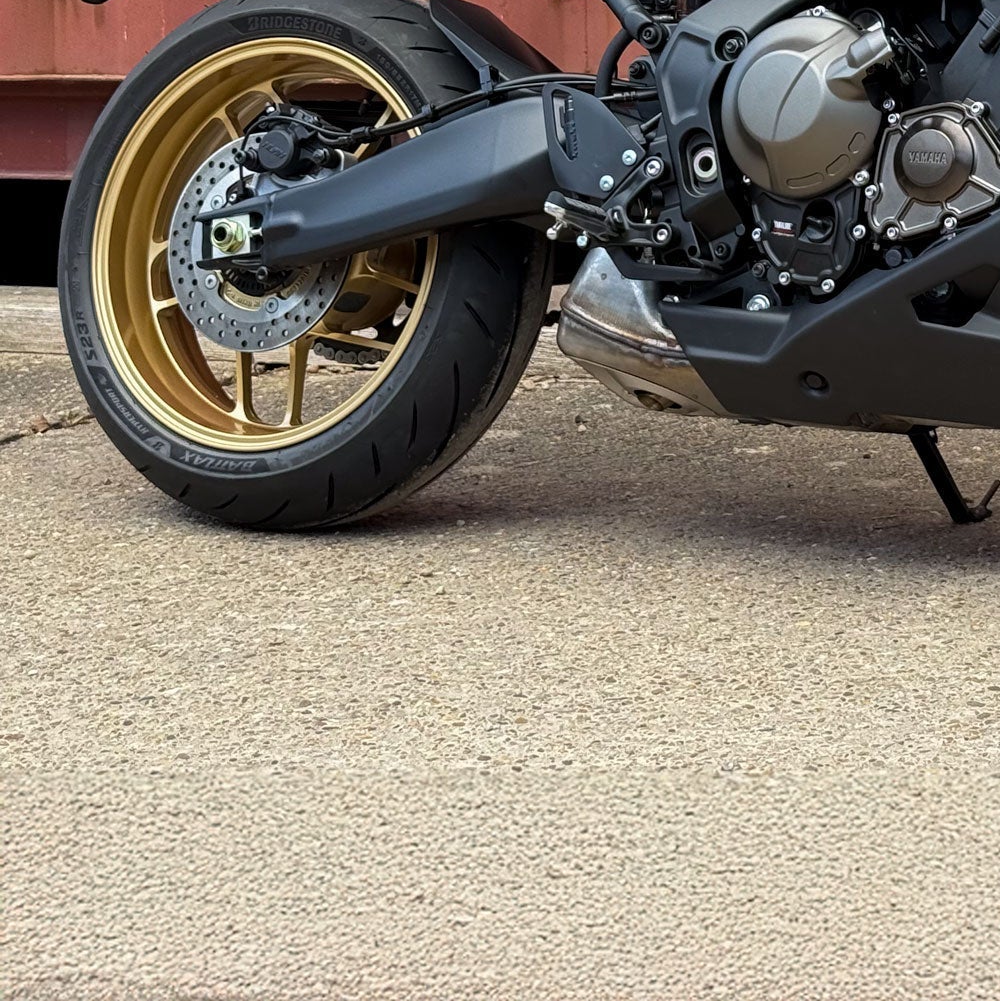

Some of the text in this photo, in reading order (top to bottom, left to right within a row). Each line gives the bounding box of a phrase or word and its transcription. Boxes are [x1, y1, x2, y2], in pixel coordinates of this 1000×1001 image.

[247, 16, 343, 40] BRIDGESTONE
[908, 150, 948, 165] YAMAHA
[105, 387, 149, 435] HYPERSPORT
[179, 451, 257, 472] BATTLAX
